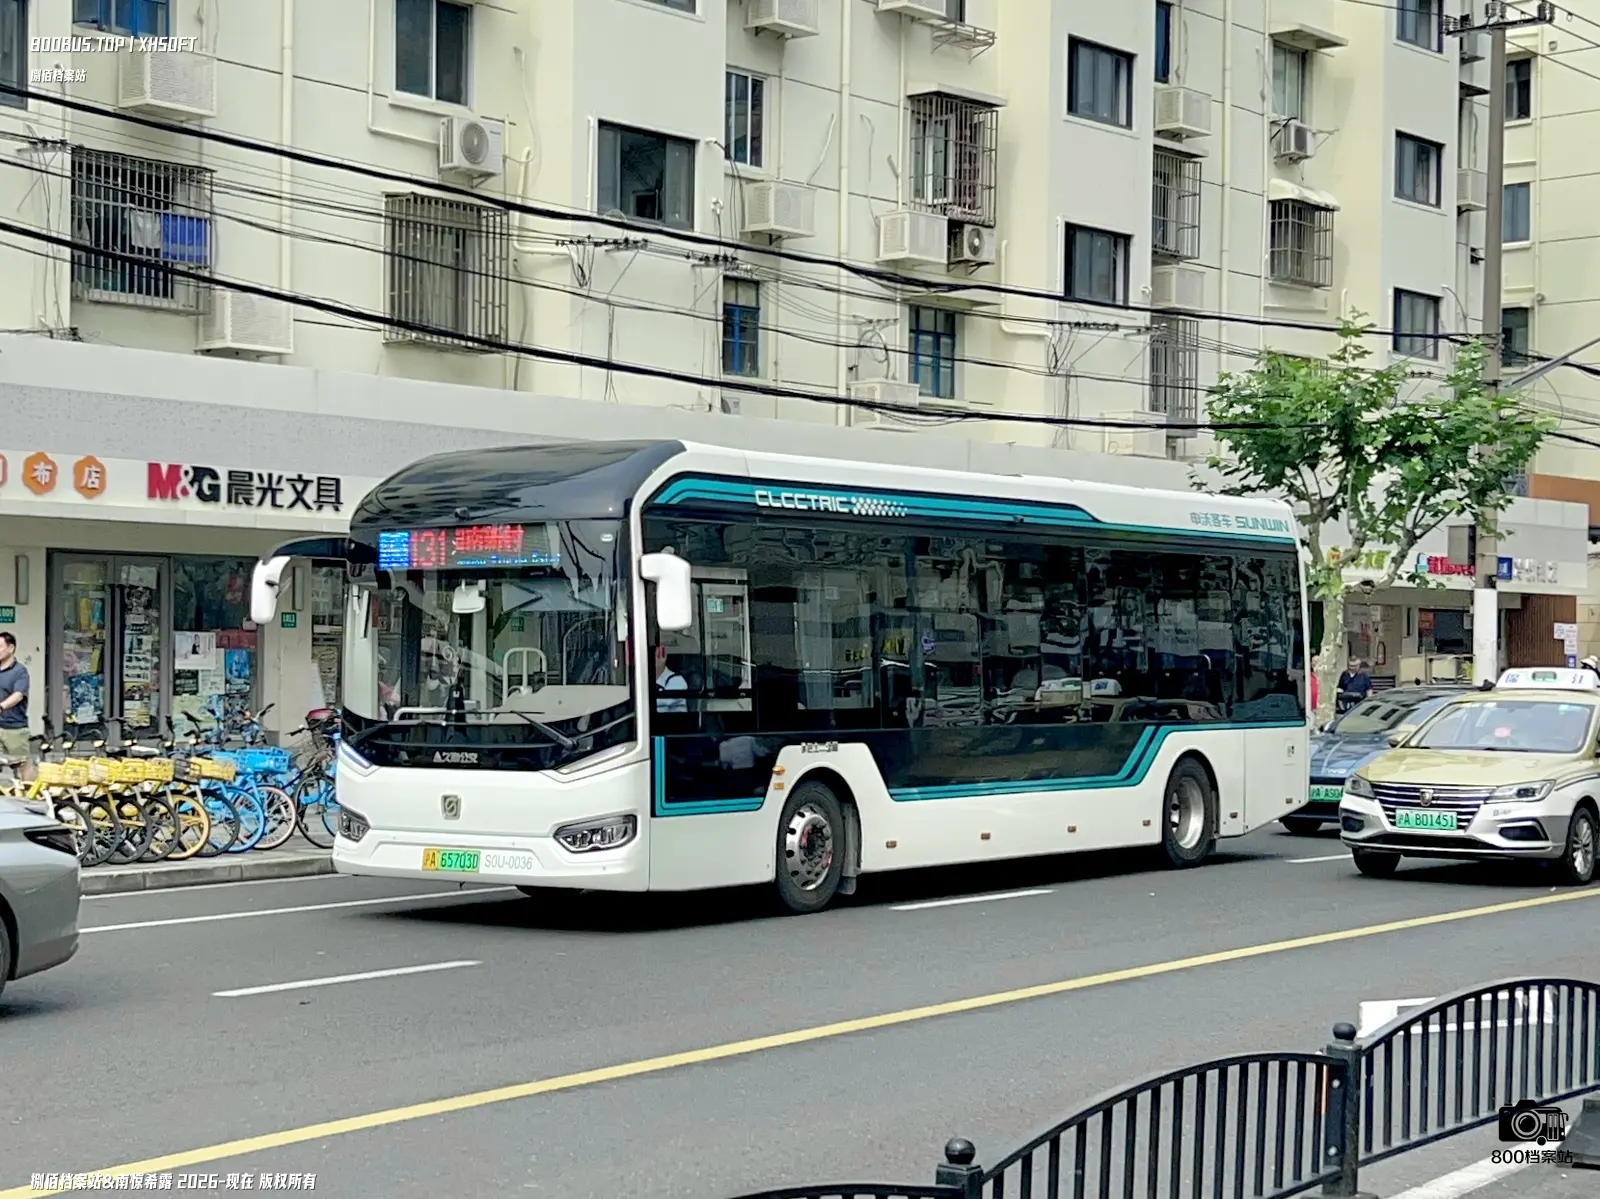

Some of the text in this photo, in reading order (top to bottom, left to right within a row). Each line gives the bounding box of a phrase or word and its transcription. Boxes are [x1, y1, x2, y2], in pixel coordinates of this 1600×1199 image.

[0, 461, 101, 490] 布店
[148, 462, 343, 512] M&G 晨光文具
[1190, 512, 1289, 532] 申沃客车 SUNWIN
[1415, 813, 1455, 827] B01451
[441, 852, 479, 869] 65703D
